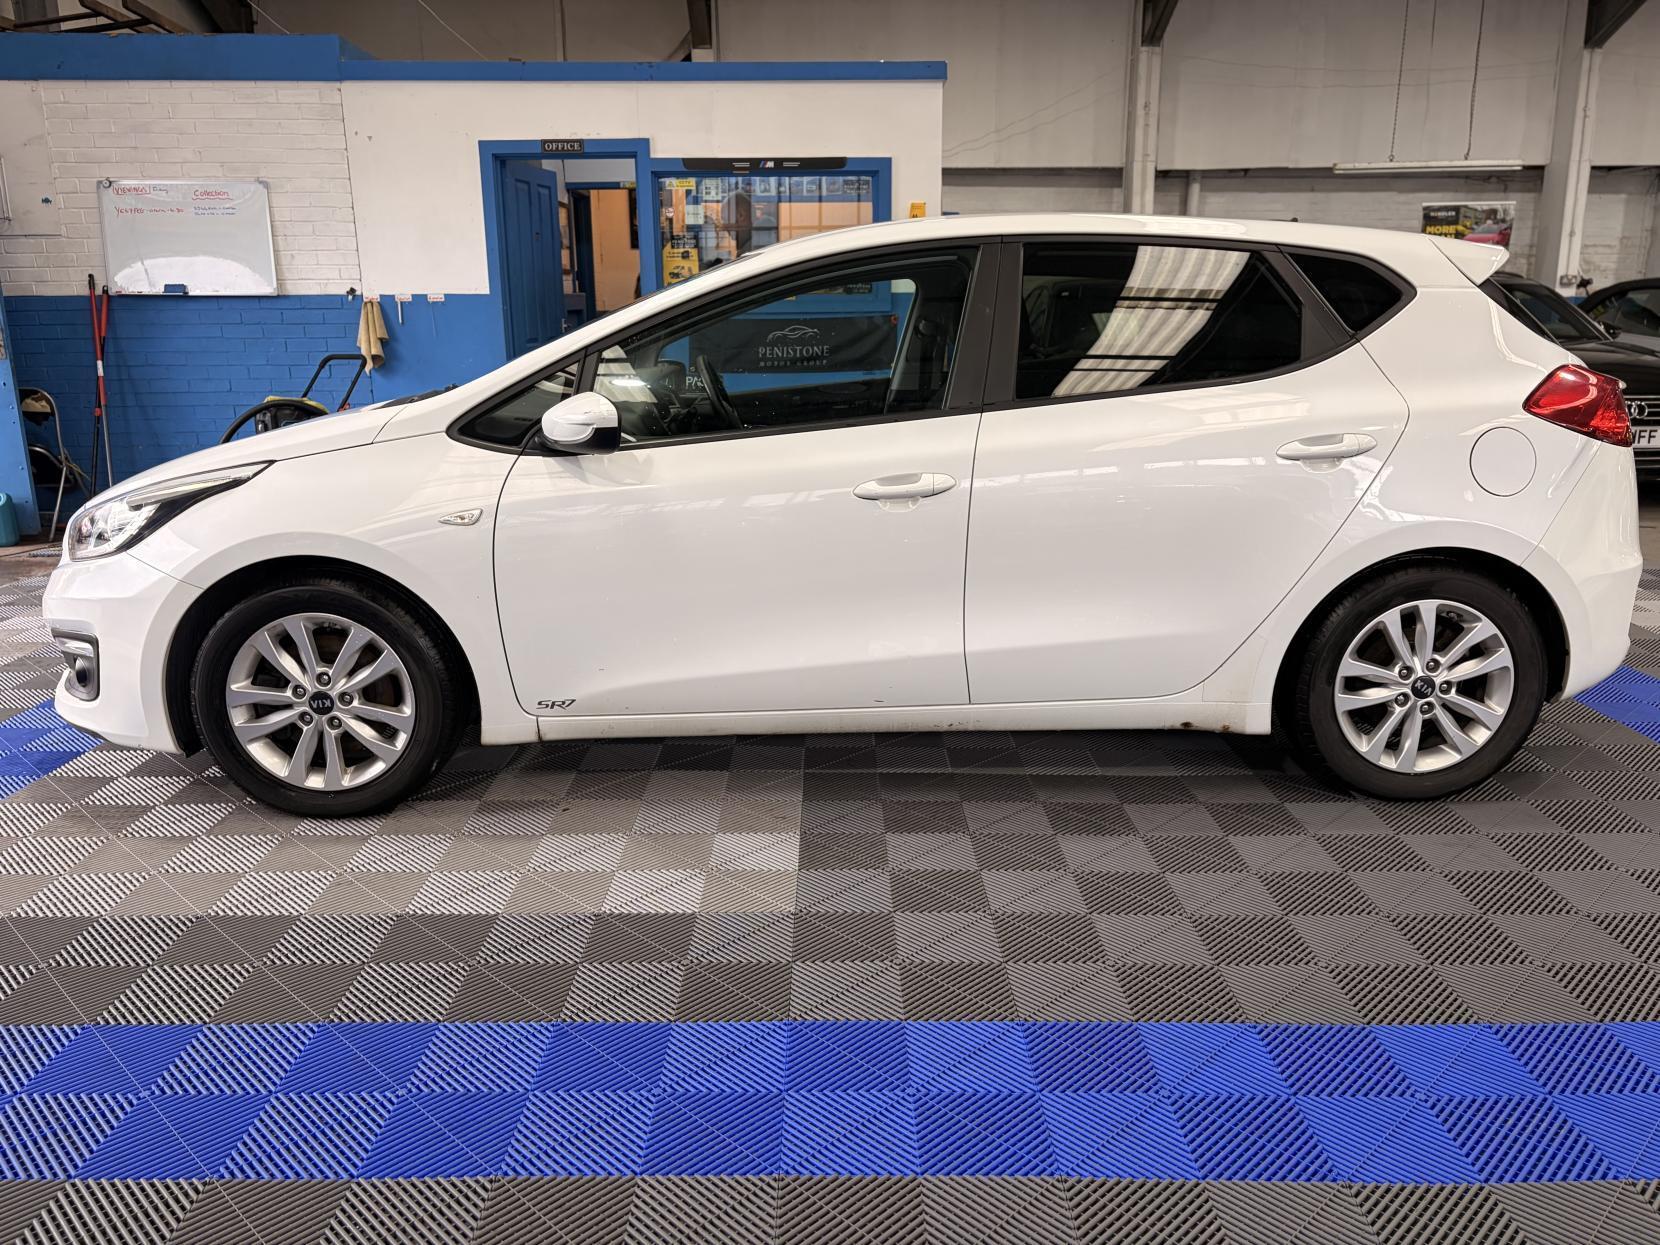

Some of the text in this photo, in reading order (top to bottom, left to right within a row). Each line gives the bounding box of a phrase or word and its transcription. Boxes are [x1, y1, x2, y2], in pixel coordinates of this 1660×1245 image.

[544, 142, 581, 151] OFFICE
[193, 189, 230, 197] Collection
[1425, 225, 1457, 234] MORE
[758, 346, 830, 358] PENISTONE
[1414, 679, 1432, 696] KIA
[310, 699, 331, 709] KIA
[535, 698, 577, 710] SR7
